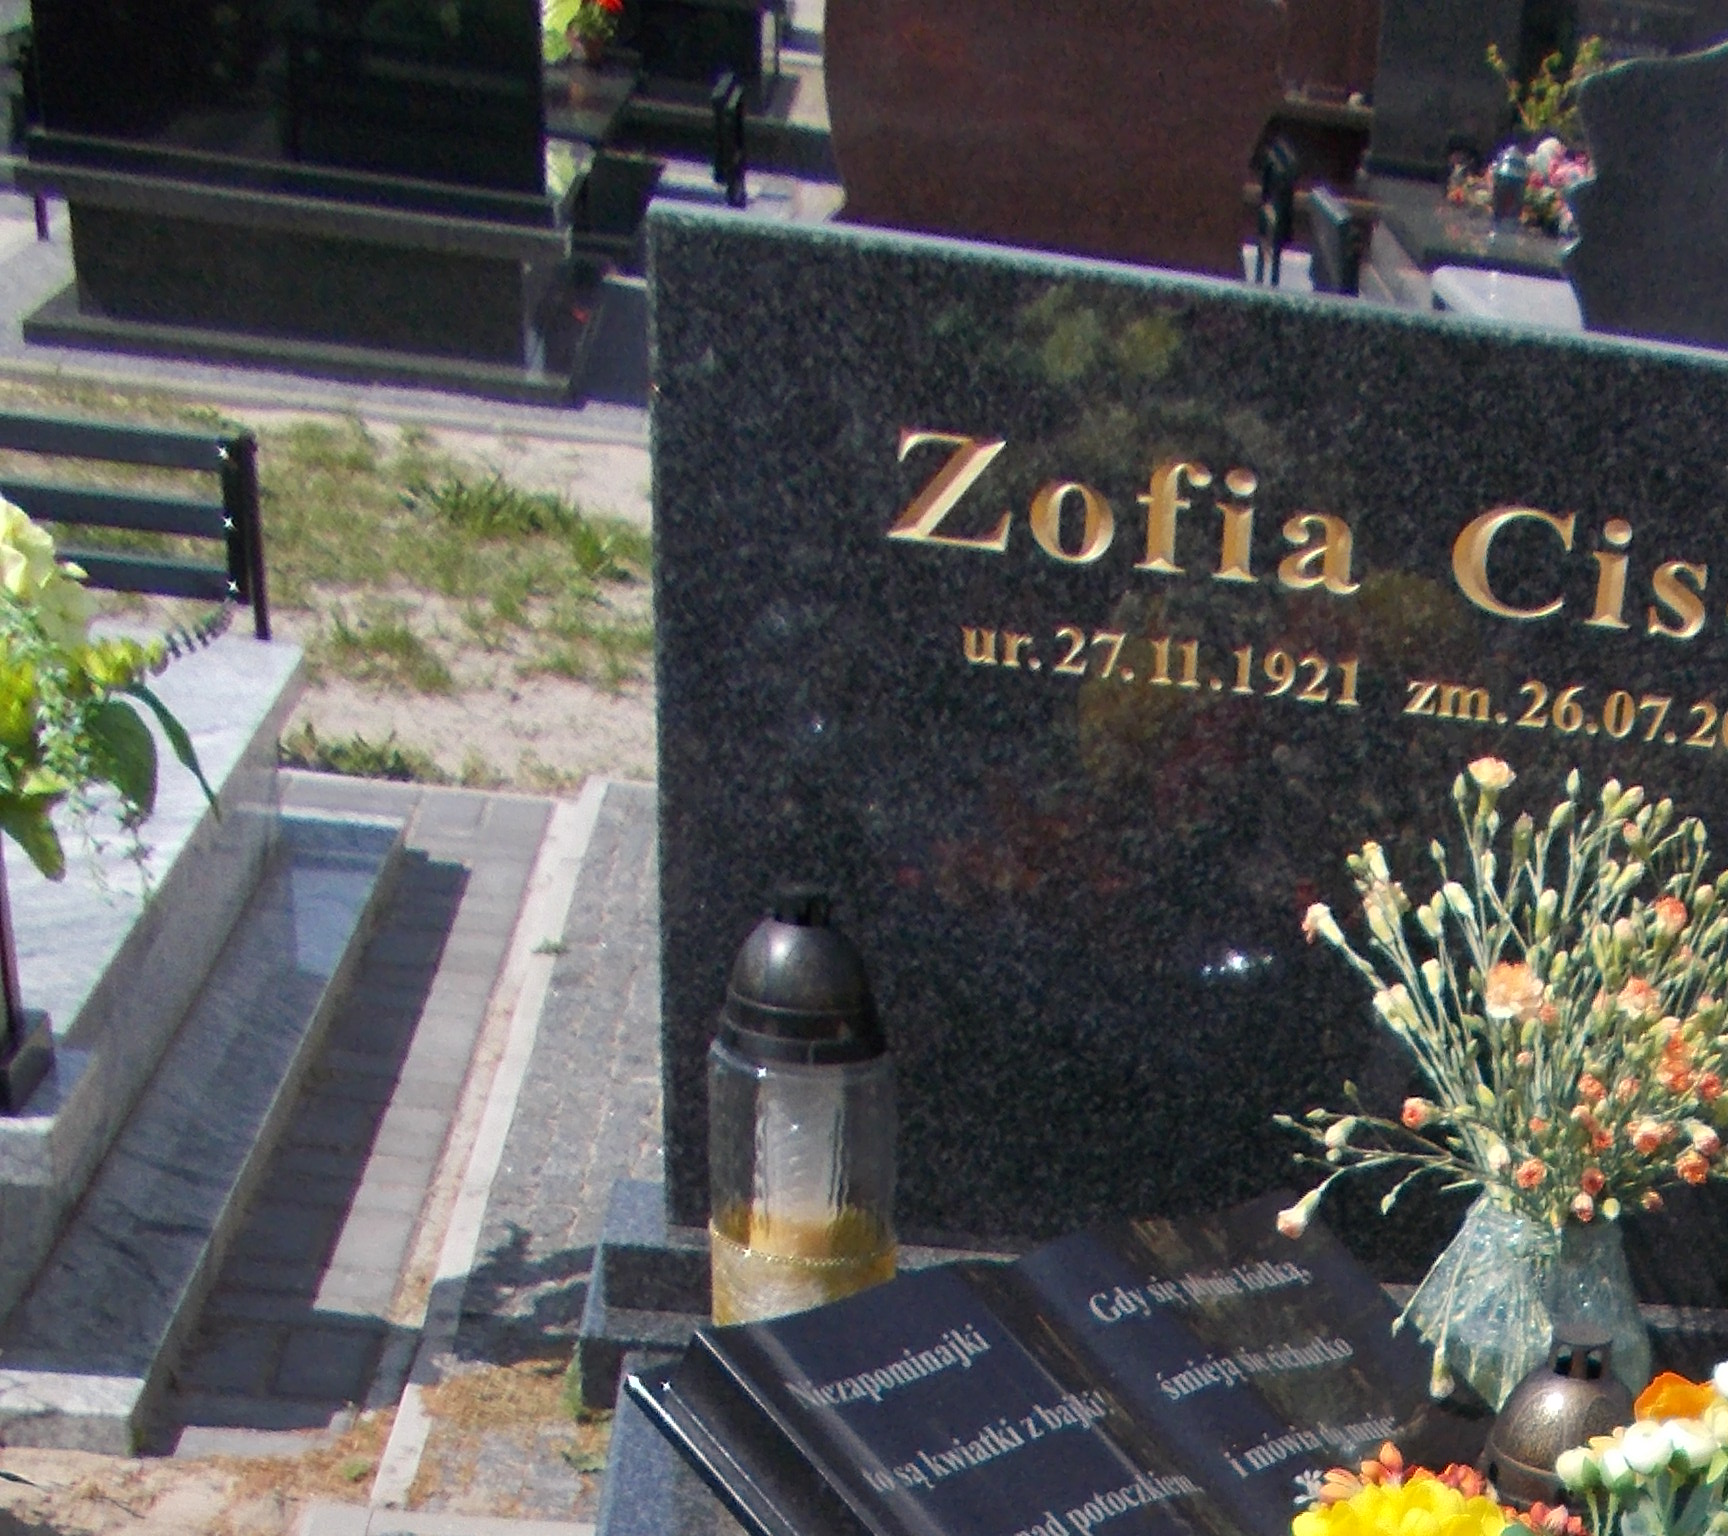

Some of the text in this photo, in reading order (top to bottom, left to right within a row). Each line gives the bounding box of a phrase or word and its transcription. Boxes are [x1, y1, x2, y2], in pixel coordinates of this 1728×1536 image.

[886, 431, 1361, 595] Zofia
[1088, 1285, 1152, 1323] Gdy
[1146, 1274, 1189, 1306] się
[784, 1322, 991, 1406] Niezapominajki
[1155, 1335, 1354, 1401] śmieją się cichutko
[860, 1388, 1116, 1493] to są kwiatki z bajki!
[1223, 1450, 1250, 1479] i
[1243, 1424, 1330, 1472] mówią
